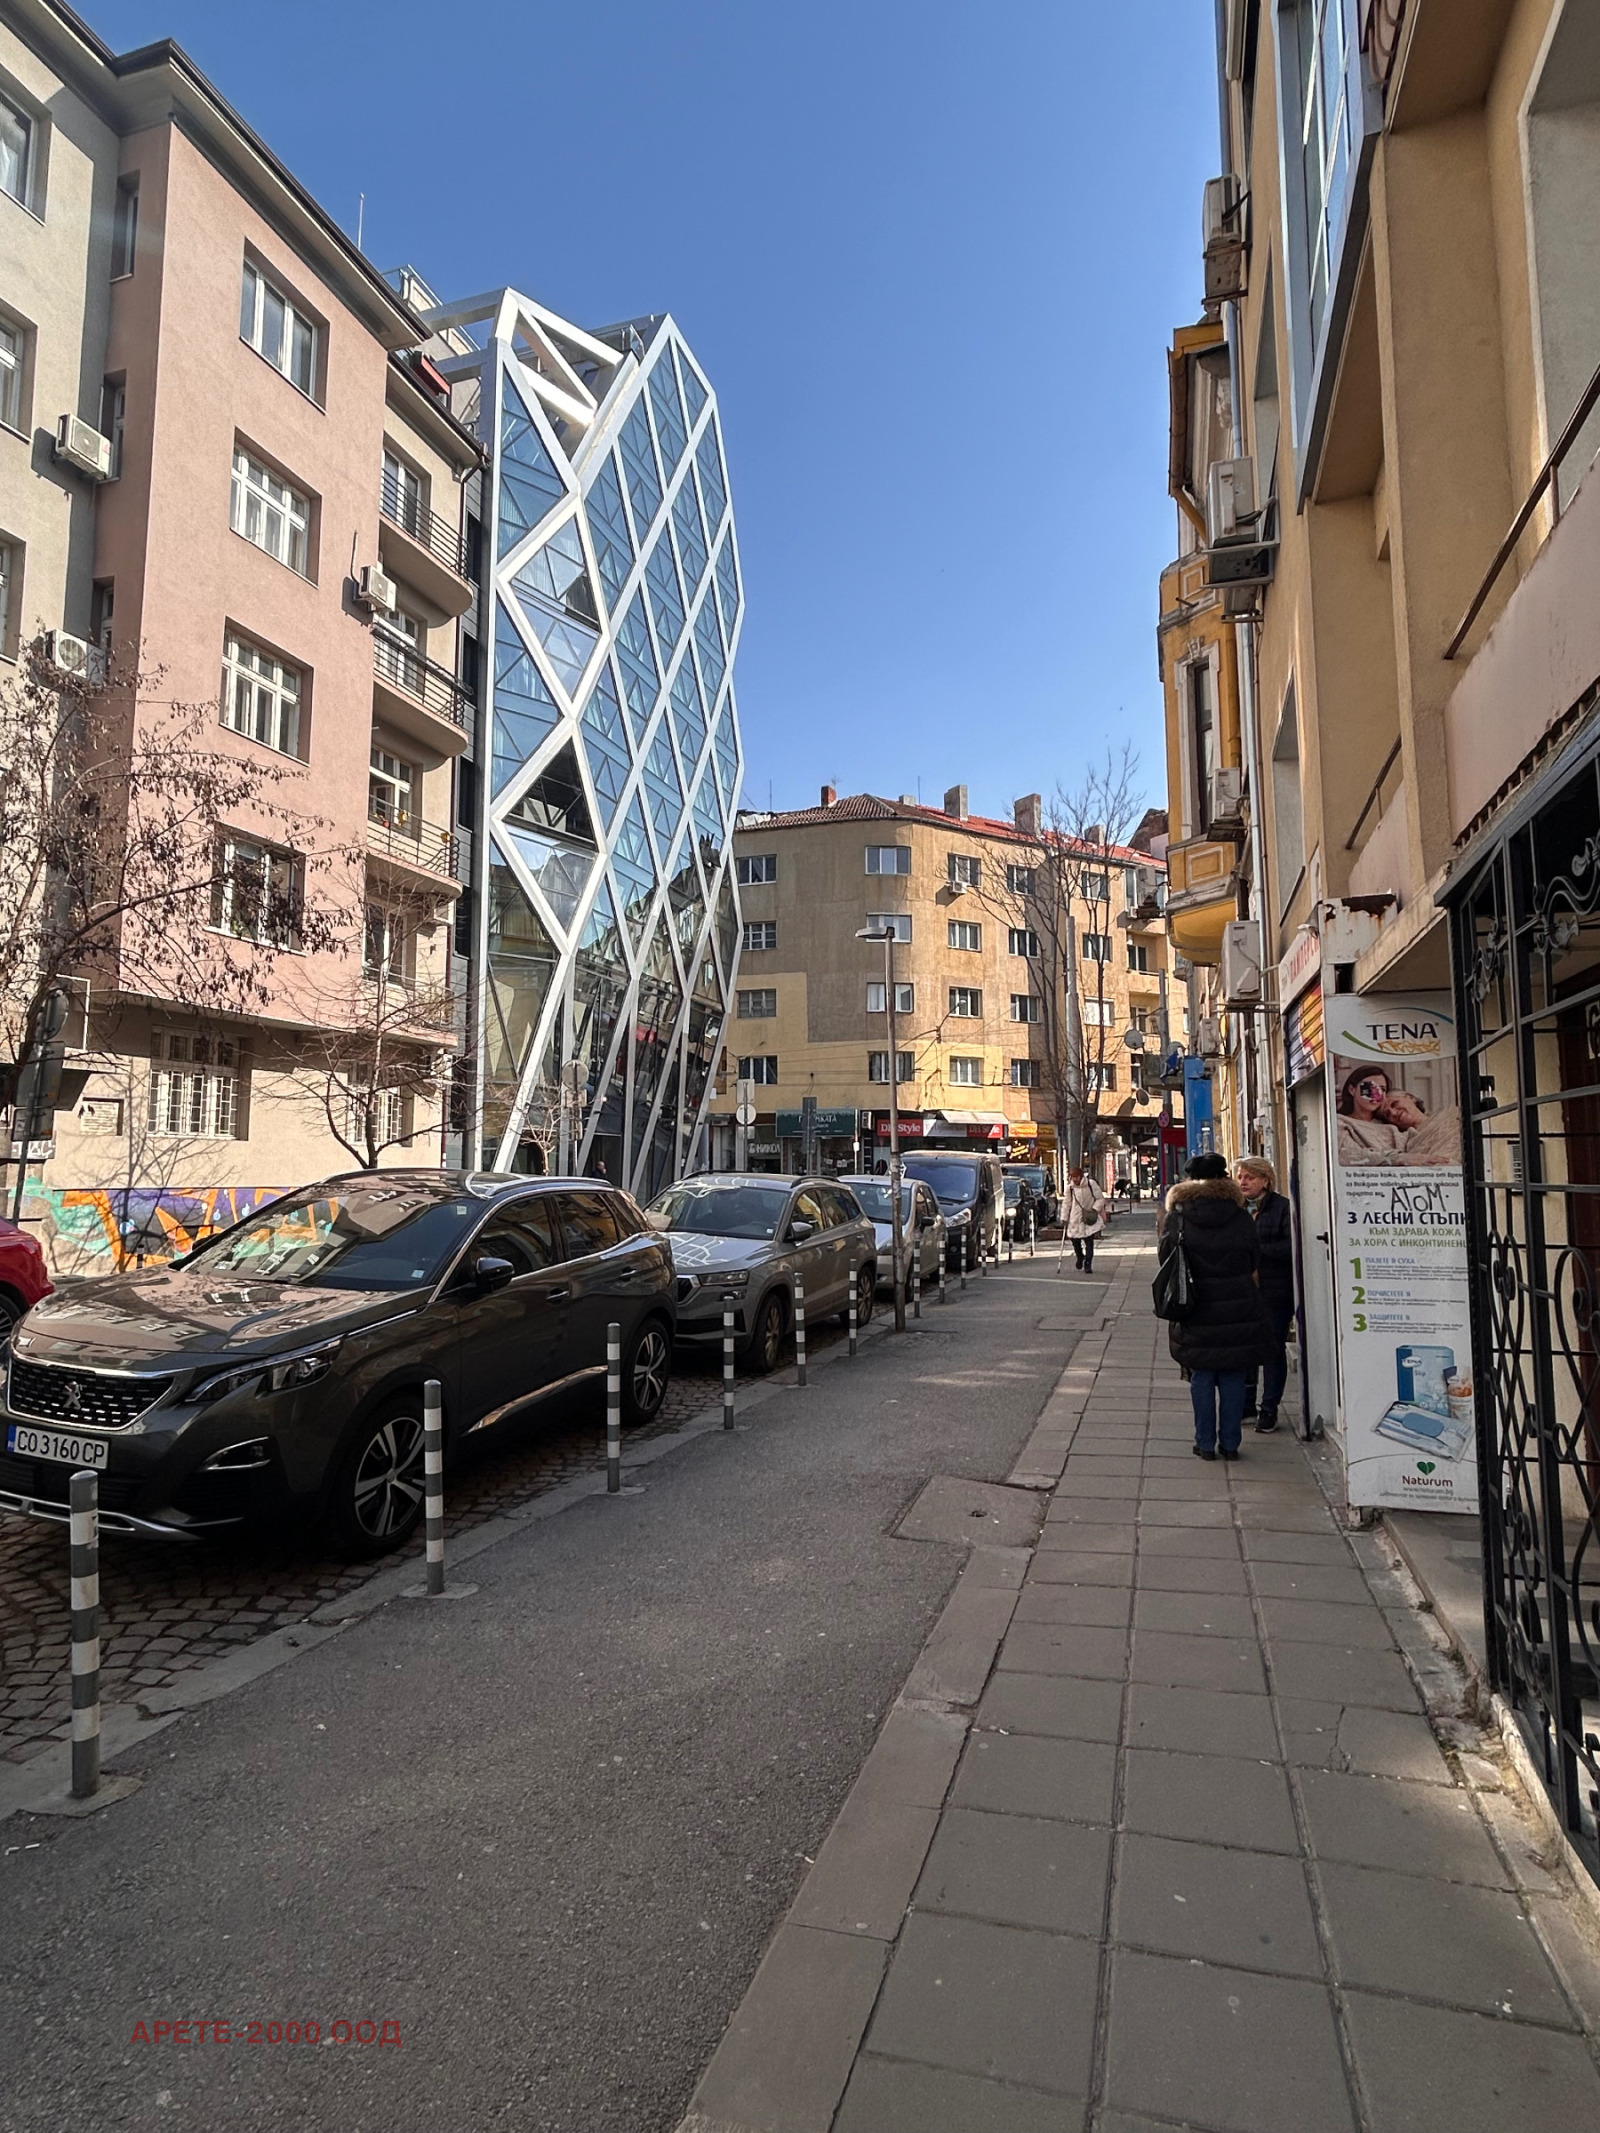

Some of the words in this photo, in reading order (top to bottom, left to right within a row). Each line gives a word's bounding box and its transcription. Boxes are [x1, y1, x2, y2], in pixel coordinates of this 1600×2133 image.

[1366, 1022, 1438, 1040] TENA
[897, 1123, 920, 1134] Style
[1347, 1211, 1358, 1225] 3
[1362, 1211, 1413, 1225] ЛЕСНИ
[1369, 1227, 1389, 1236] КЪМ
[1392, 1227, 1429, 1237] ЗДРАВА
[1432, 1228, 1461, 1237] КОЖА
[1349, 1238, 1361, 1247] ЗА
[1364, 1238, 1388, 1247] ХОРА
[1391, 1239, 1397, 1247] С
[1349, 1257, 1362, 1279] 1
[1352, 1286, 1365, 1304] 2
[1353, 1313, 1367, 1332] 3
[40, 1435, 79, 1460] 3160
[1402, 1475, 1453, 1487] Naturum
